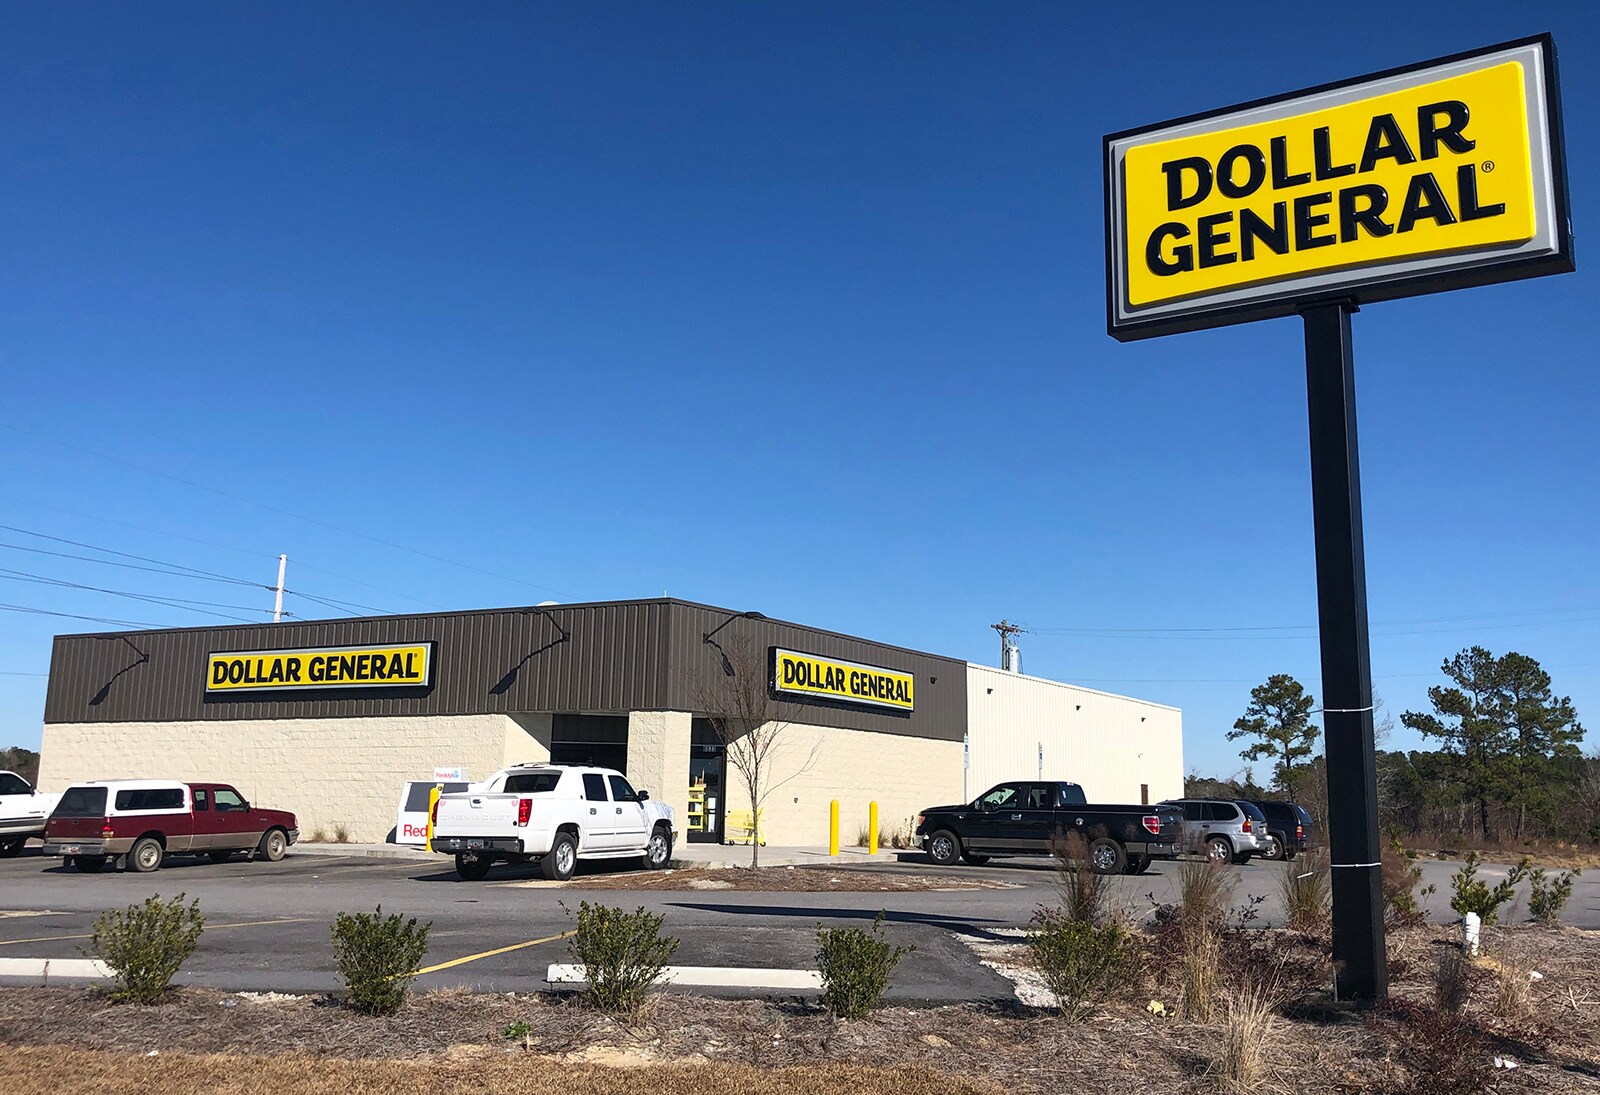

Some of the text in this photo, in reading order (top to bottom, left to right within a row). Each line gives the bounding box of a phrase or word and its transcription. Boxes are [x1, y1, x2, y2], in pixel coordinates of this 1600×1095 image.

[1161, 100, 1476, 211] DOLLAR
[1146, 163, 1506, 276] GENERAL
[213, 653, 419, 684] DOLLAR GENERAL
[783, 658, 912, 703] DOLLAR GENERAL
